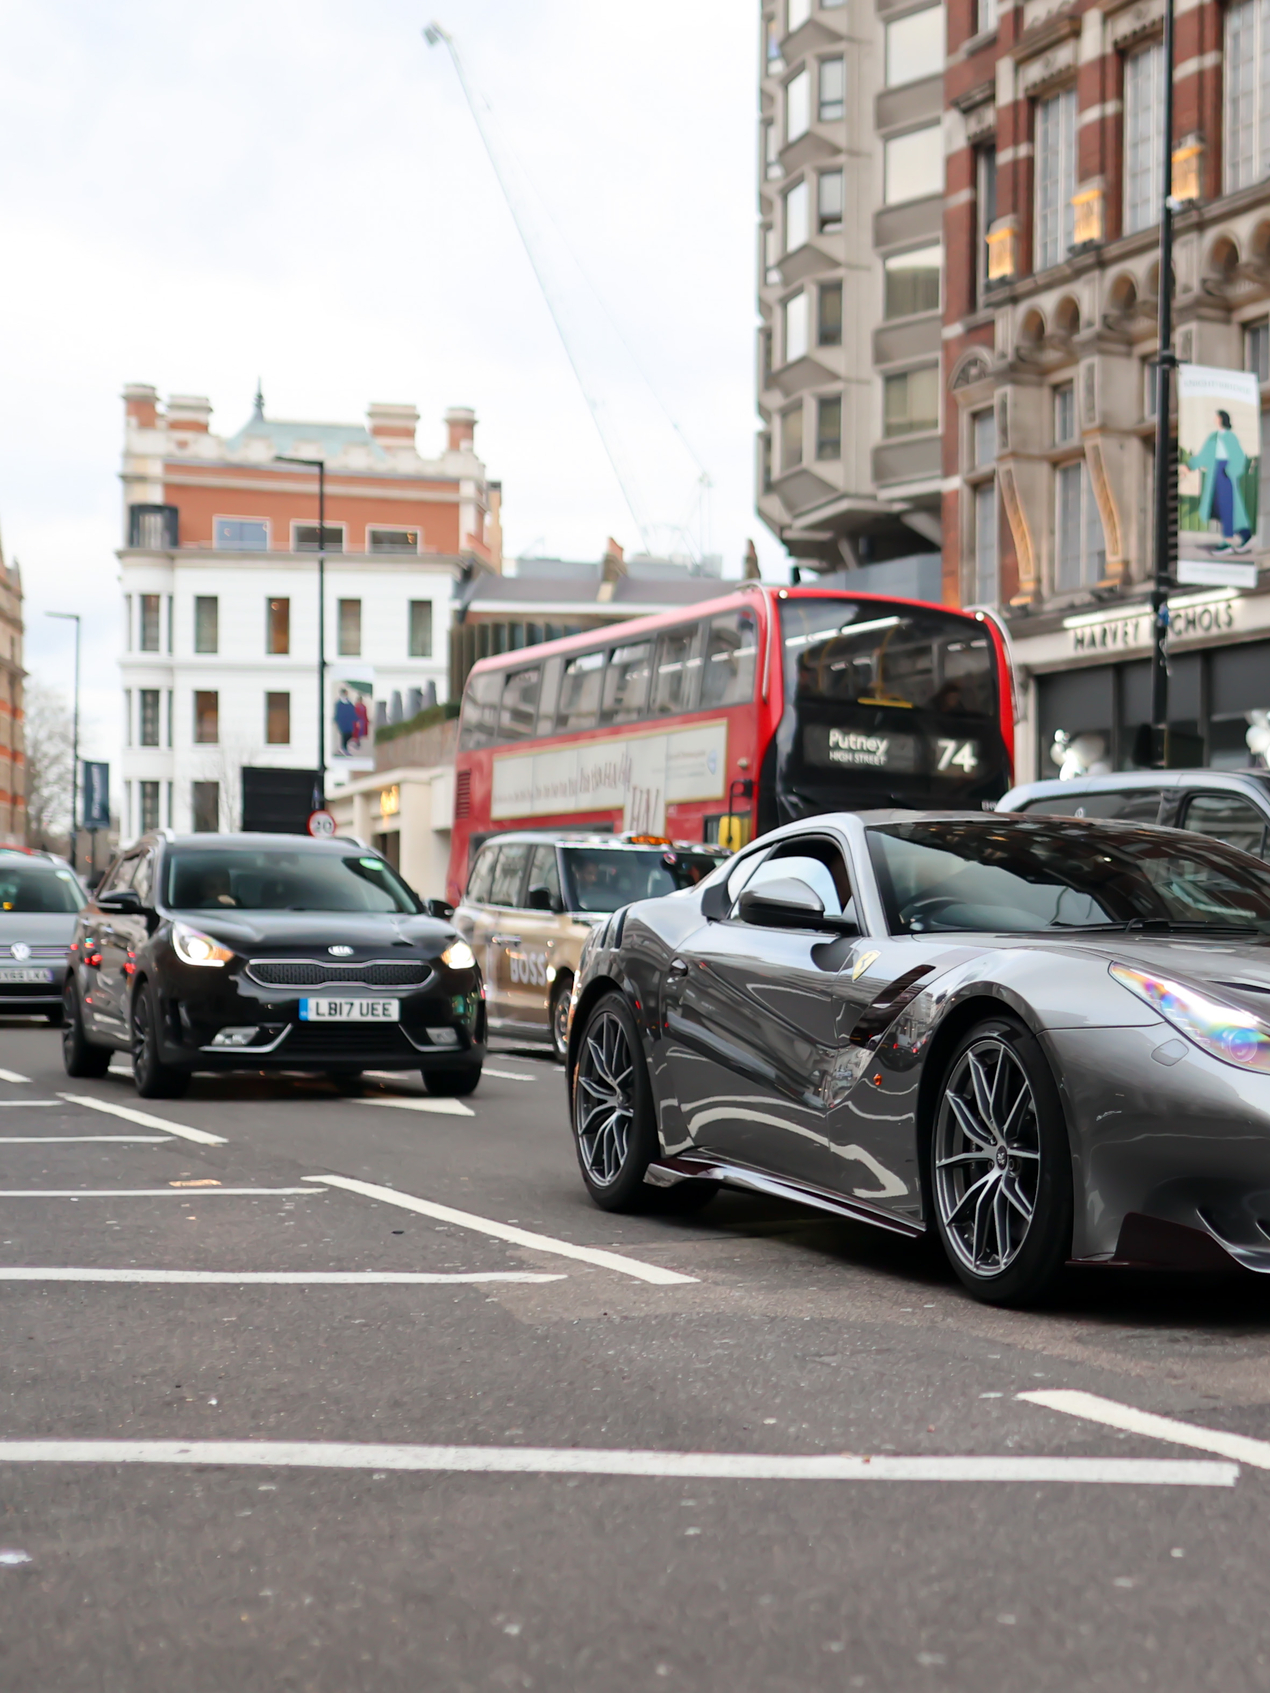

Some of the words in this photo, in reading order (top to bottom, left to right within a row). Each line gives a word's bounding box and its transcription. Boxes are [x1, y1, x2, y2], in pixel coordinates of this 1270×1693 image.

[1074, 619, 1140, 651] HARVEY
[1152, 604, 1234, 639] CHOLS
[829, 728, 889, 756] Putney
[937, 738, 979, 773] 74
[829, 750, 852, 763] HIGH
[854, 752, 887, 766] STREET
[510, 950, 546, 987] BOSS
[315, 1001, 354, 1017] LB17
[360, 1001, 392, 1017] UEE
